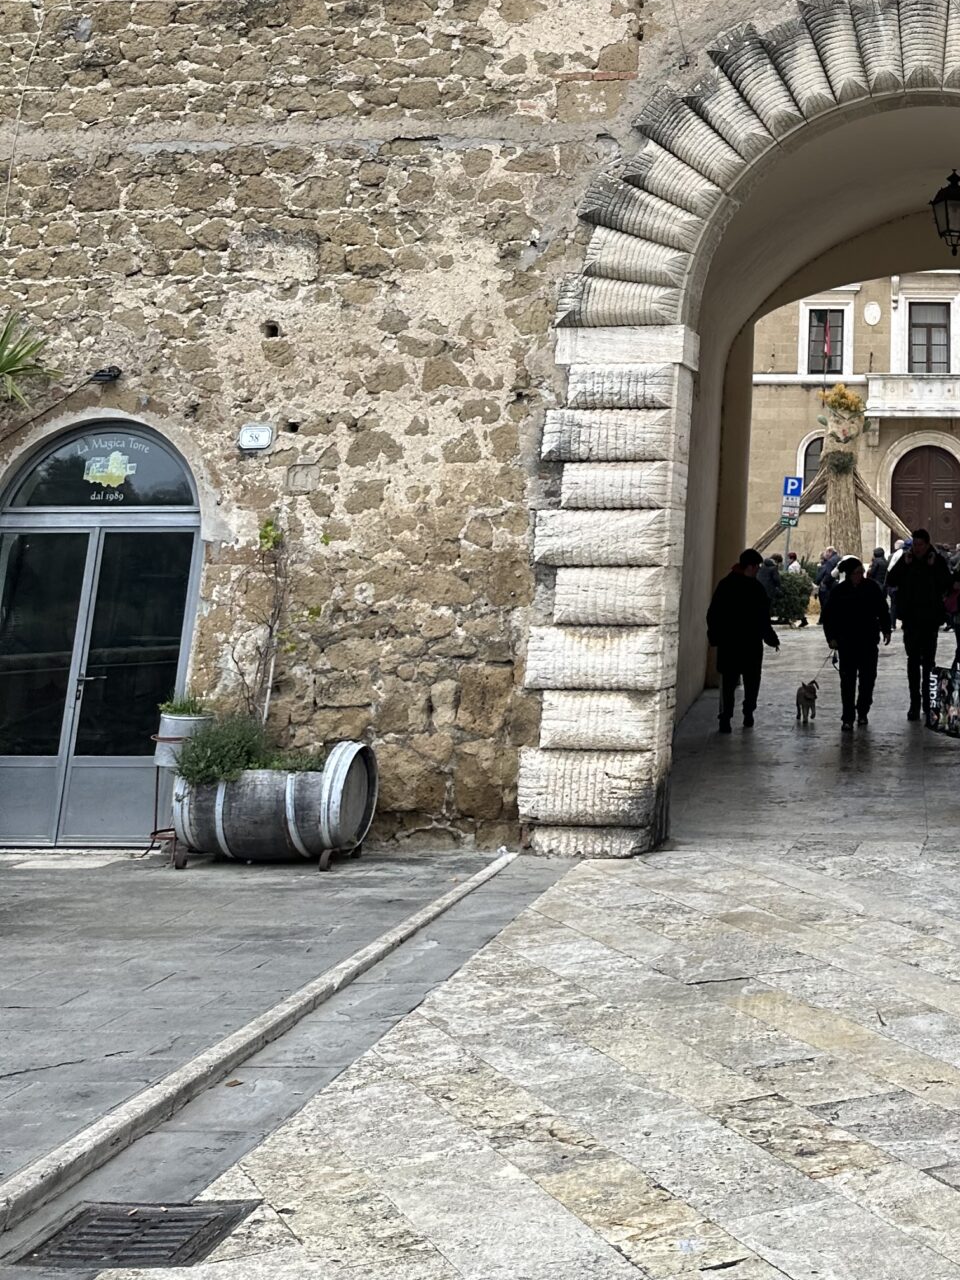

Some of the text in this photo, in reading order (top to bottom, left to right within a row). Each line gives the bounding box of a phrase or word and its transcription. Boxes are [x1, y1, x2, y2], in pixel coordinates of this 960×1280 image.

[77, 437, 150, 455] La Magica Torre
[787, 478, 799, 494] P
[90, 491, 124, 501] dal 1989
